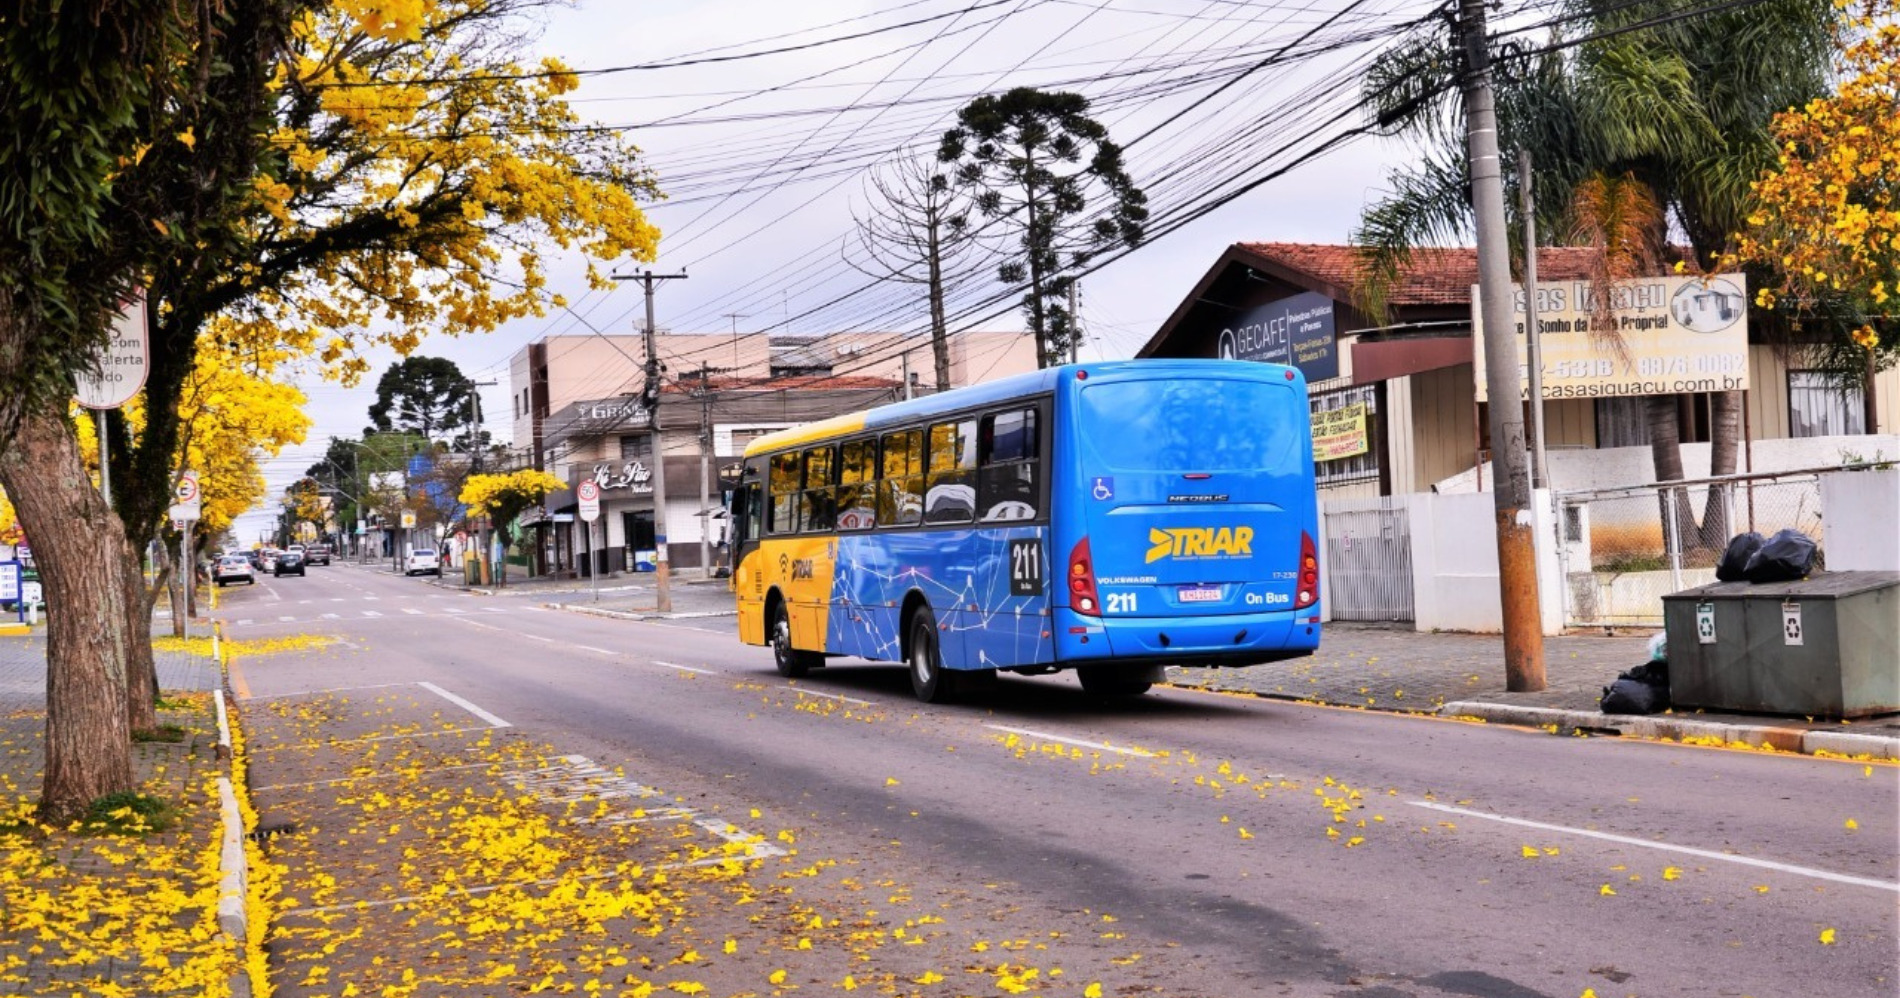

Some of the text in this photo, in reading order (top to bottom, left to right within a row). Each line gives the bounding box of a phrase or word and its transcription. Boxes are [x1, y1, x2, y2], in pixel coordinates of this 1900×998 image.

[1574, 318, 1588, 332] da
[1621, 313, 1668, 332] Própria!
[1238, 317, 1287, 353] GECAFE
[1169, 494, 1229, 502] NEOBUS
[1162, 526, 1254, 556] TRIAR
[1013, 543, 1039, 579] 211
[1097, 576, 1157, 584] VOLKSWAGEN
[1107, 592, 1137, 612] 211
[1245, 592, 1289, 604] On Bus
